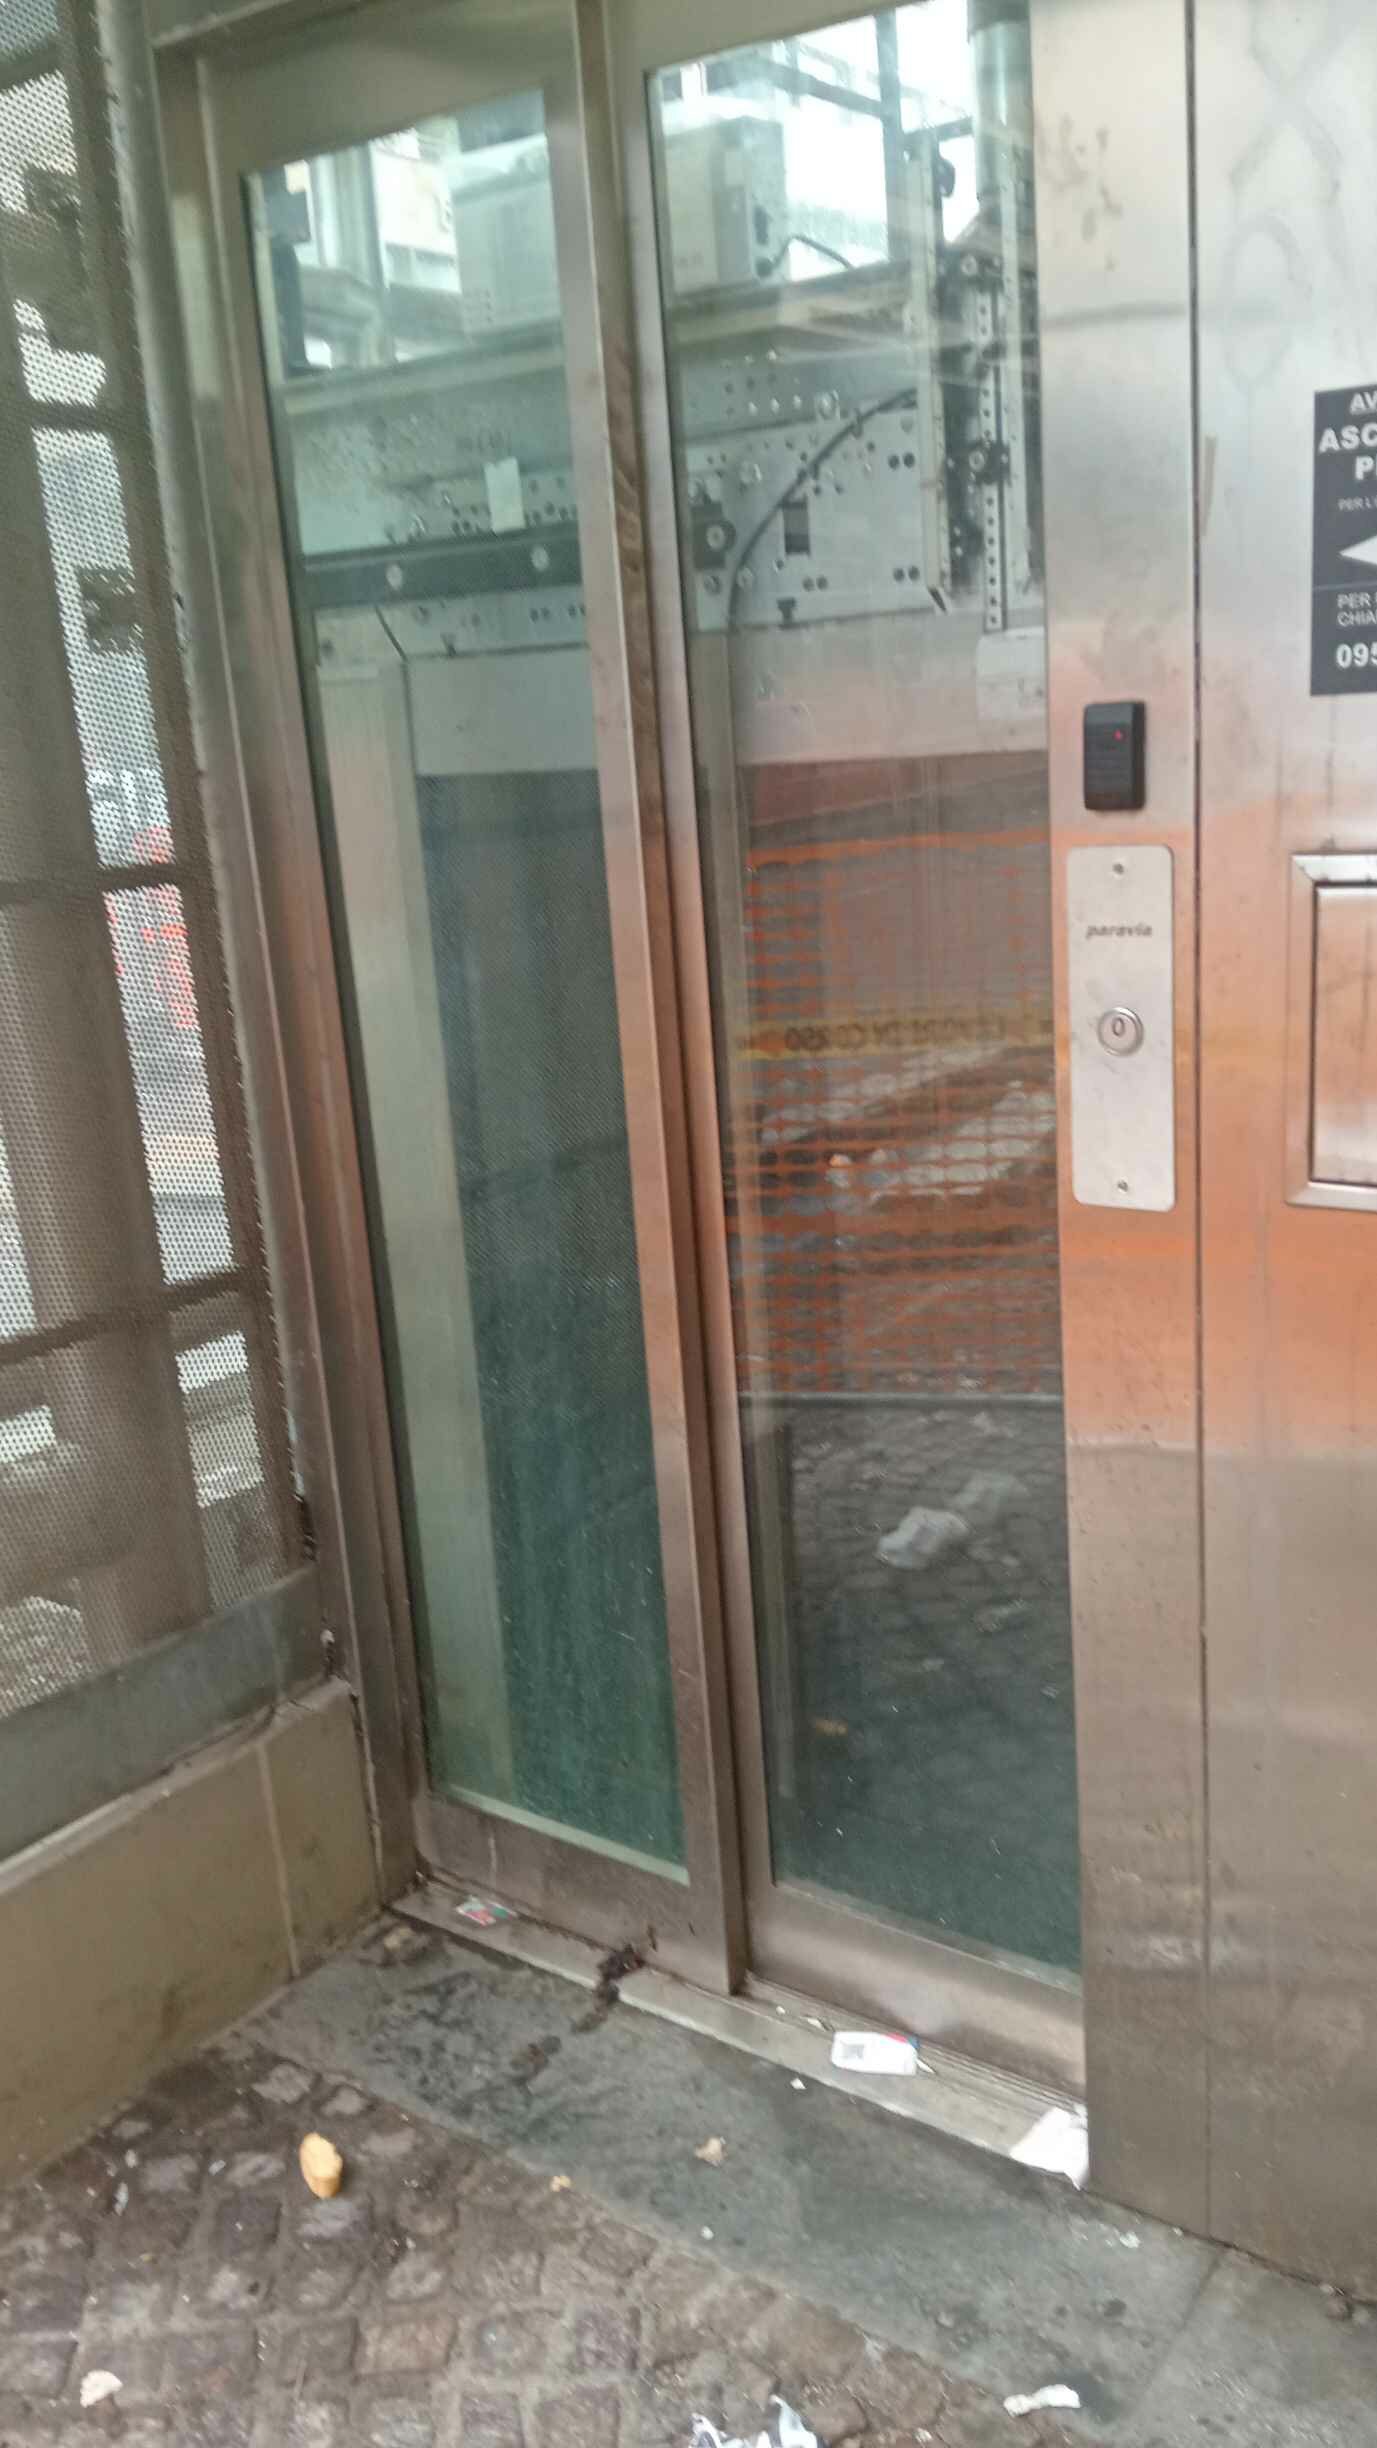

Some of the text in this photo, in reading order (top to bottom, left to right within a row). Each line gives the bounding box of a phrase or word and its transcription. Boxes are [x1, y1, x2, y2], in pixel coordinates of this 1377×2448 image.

[1350, 390, 1377, 413] AV
[1319, 421, 1377, 452] ASC
[1355, 455, 1377, 480] P
[1337, 592, 1371, 609] PER
[1337, 609, 1377, 627] CHIA
[1085, 922, 1153, 940] paravia
